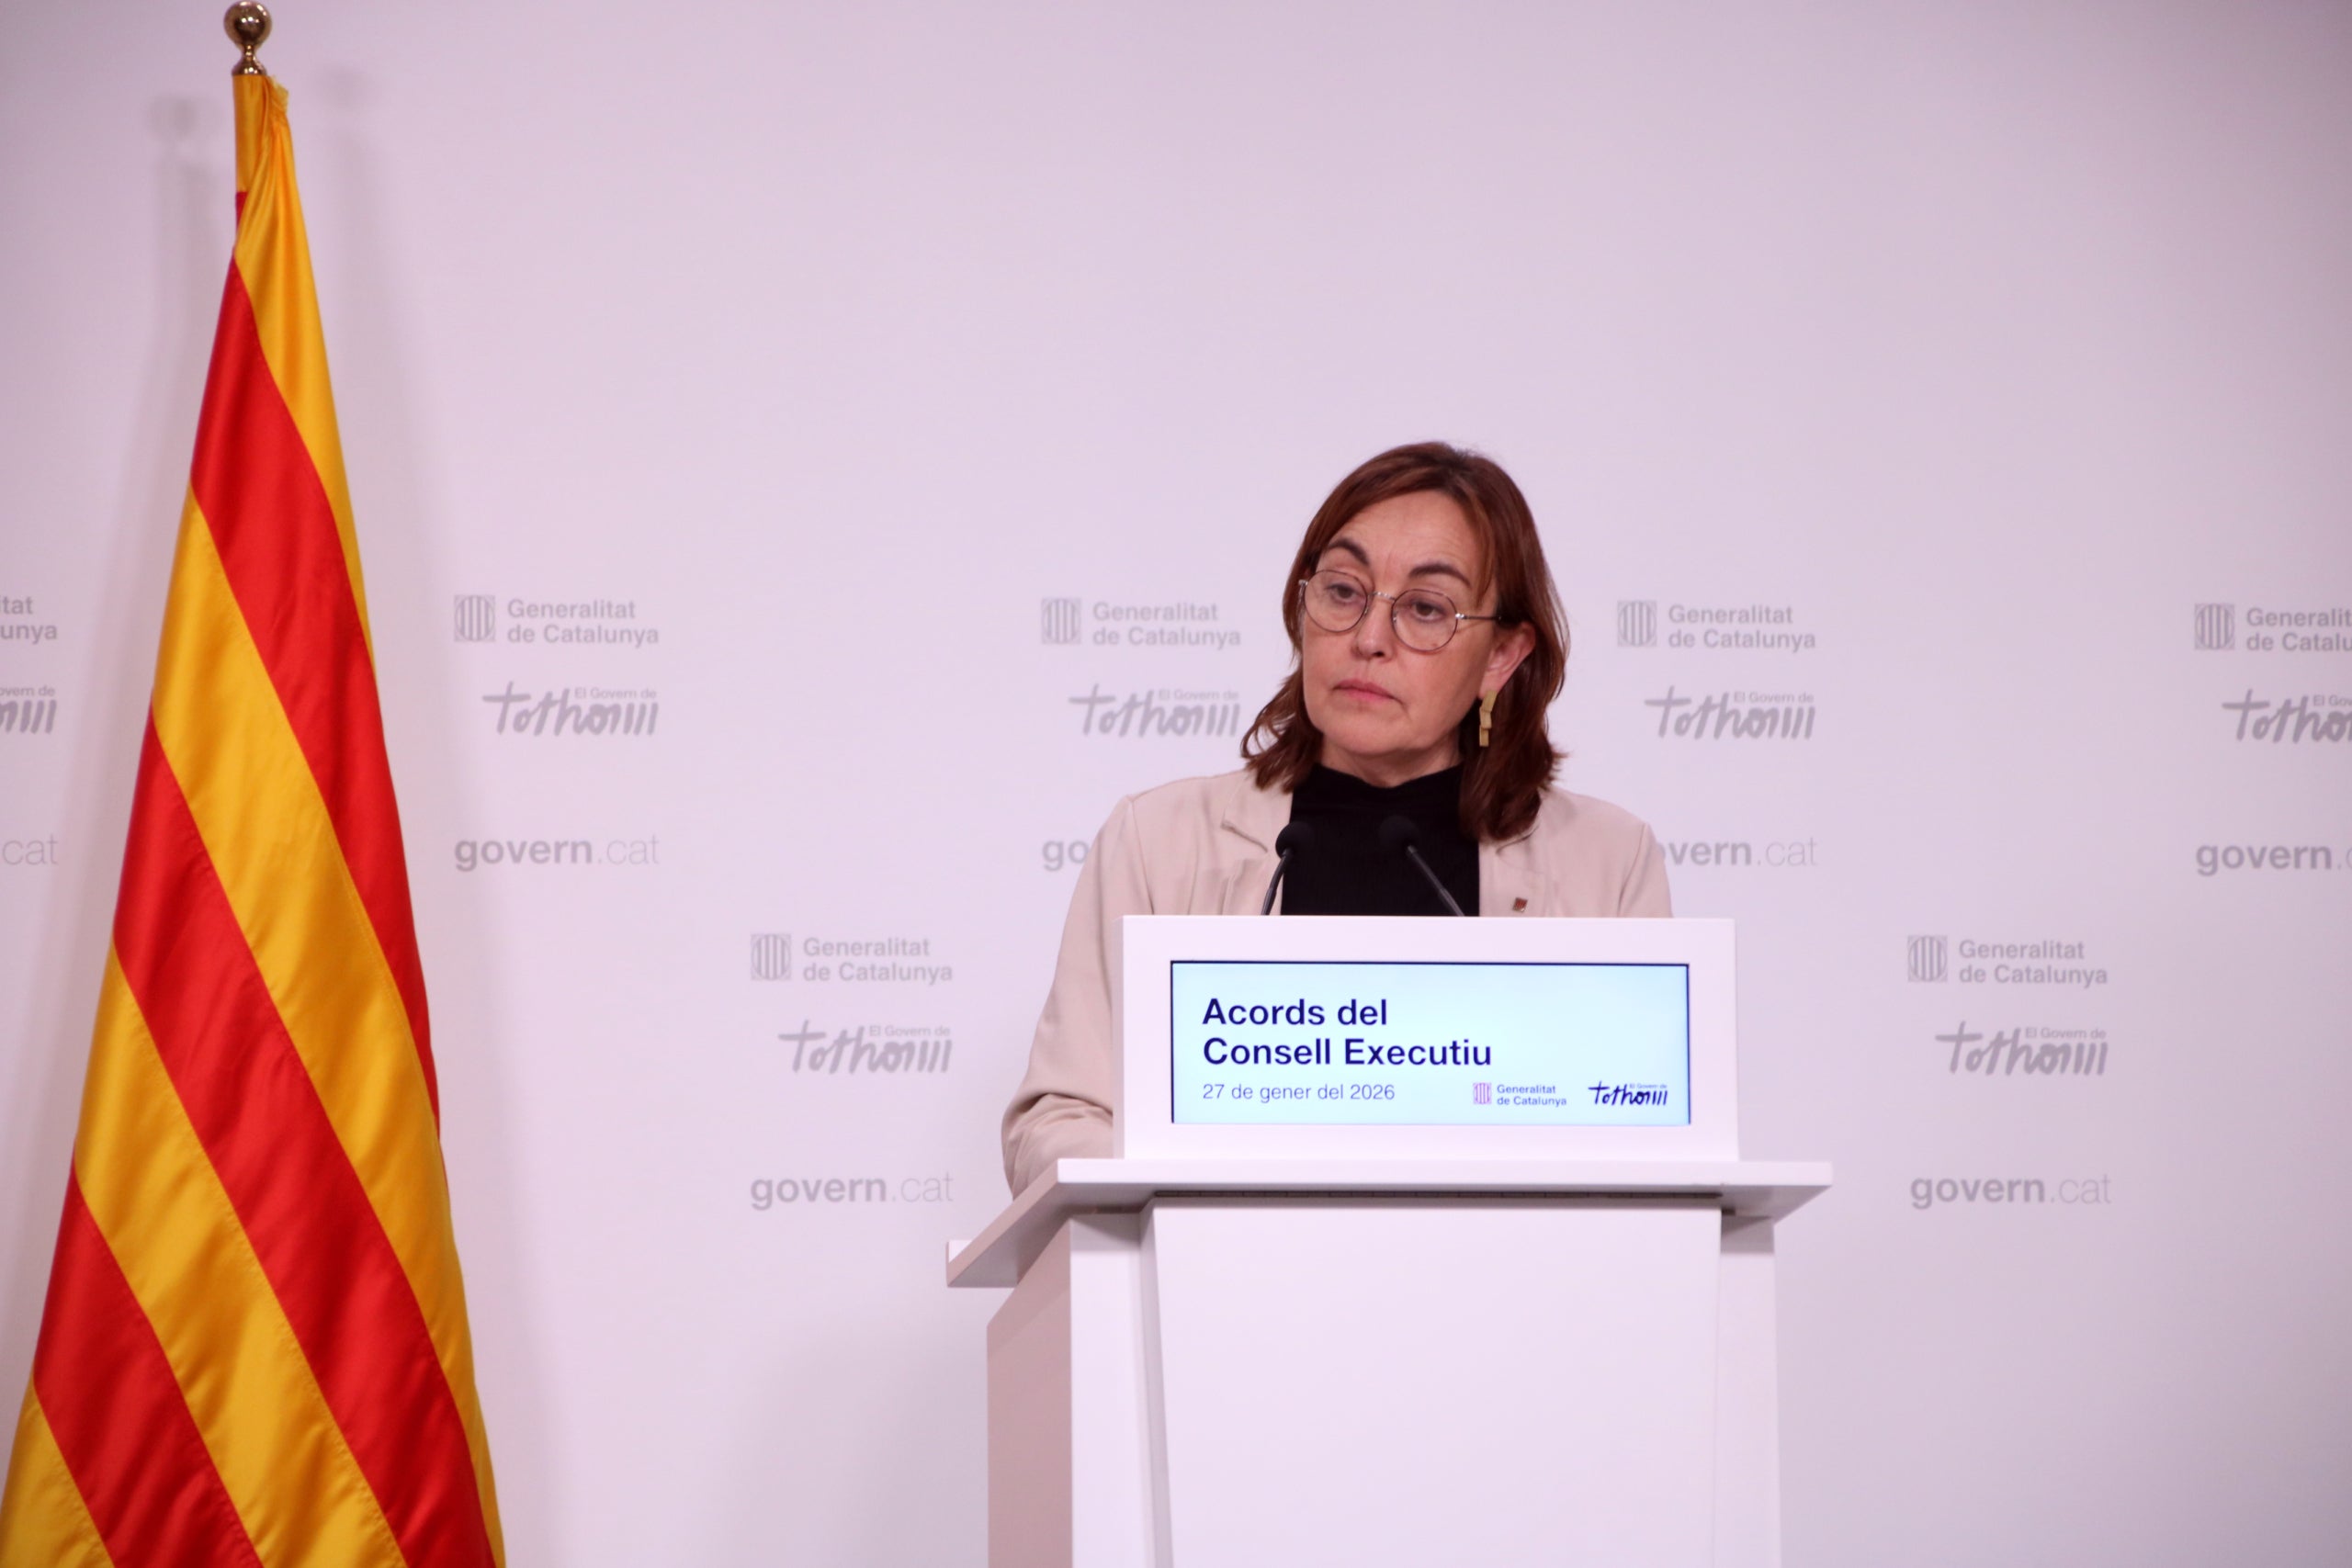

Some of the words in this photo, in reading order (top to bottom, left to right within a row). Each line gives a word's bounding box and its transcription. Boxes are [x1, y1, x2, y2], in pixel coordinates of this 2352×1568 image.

[508, 599, 635, 618] Generalitat
[1093, 602, 1217, 621] Generalitat
[1669, 604, 1792, 624] Generalitat
[2246, 607, 2352, 627] Generalit
[508, 625, 535, 643] de
[544, 625, 659, 649] Catalunya
[1093, 627, 1119, 646] de
[1128, 627, 1239, 650] Catalunya
[1669, 630, 1695, 649] de
[1703, 629, 1815, 652] Catalunya
[2246, 633, 2273, 651] de
[2282, 632, 2352, 652] Catalu
[39, 685, 55, 696] de
[590, 687, 637, 698] Govern
[640, 688, 656, 698] de
[1173, 690, 1219, 701] Govern
[1223, 690, 1238, 700] de
[1749, 692, 1794, 704] Govern
[1798, 693, 1814, 703] de
[455, 835, 659, 872] govern.cat
[1656, 838, 1816, 866] vern.cat
[2196, 844, 2352, 876] govern.
[803, 938, 930, 956] Generalitat
[1960, 940, 2084, 959] Generalitat
[803, 963, 831, 981] de
[839, 962, 952, 986] Catalunya
[1960, 964, 1985, 983] de
[1995, 964, 2108, 988] Catalunya
[1203, 998, 1325, 1025] Acords
[1338, 999, 1386, 1025] del
[885, 1025, 931, 1037] Govern
[934, 1026, 950, 1036] de
[2041, 1027, 2086, 1039] Govern
[2090, 1028, 2106, 1038] de
[1204, 1038, 1330, 1065] Consell
[1345, 1039, 1490, 1065] Executiu
[1203, 1084, 1224, 1099] 27
[1231, 1084, 1253, 1099] de
[1261, 1088, 1311, 1103] gener
[1317, 1084, 1343, 1099] del
[1351, 1084, 1395, 1100] 2026
[1497, 1085, 1555, 1094] Generalitat
[1498, 1097, 1510, 1105] de
[1513, 1097, 1566, 1108] Catalunya
[751, 1171, 953, 1211] govern.cat
[1911, 1174, 2111, 1210] govern.cat
